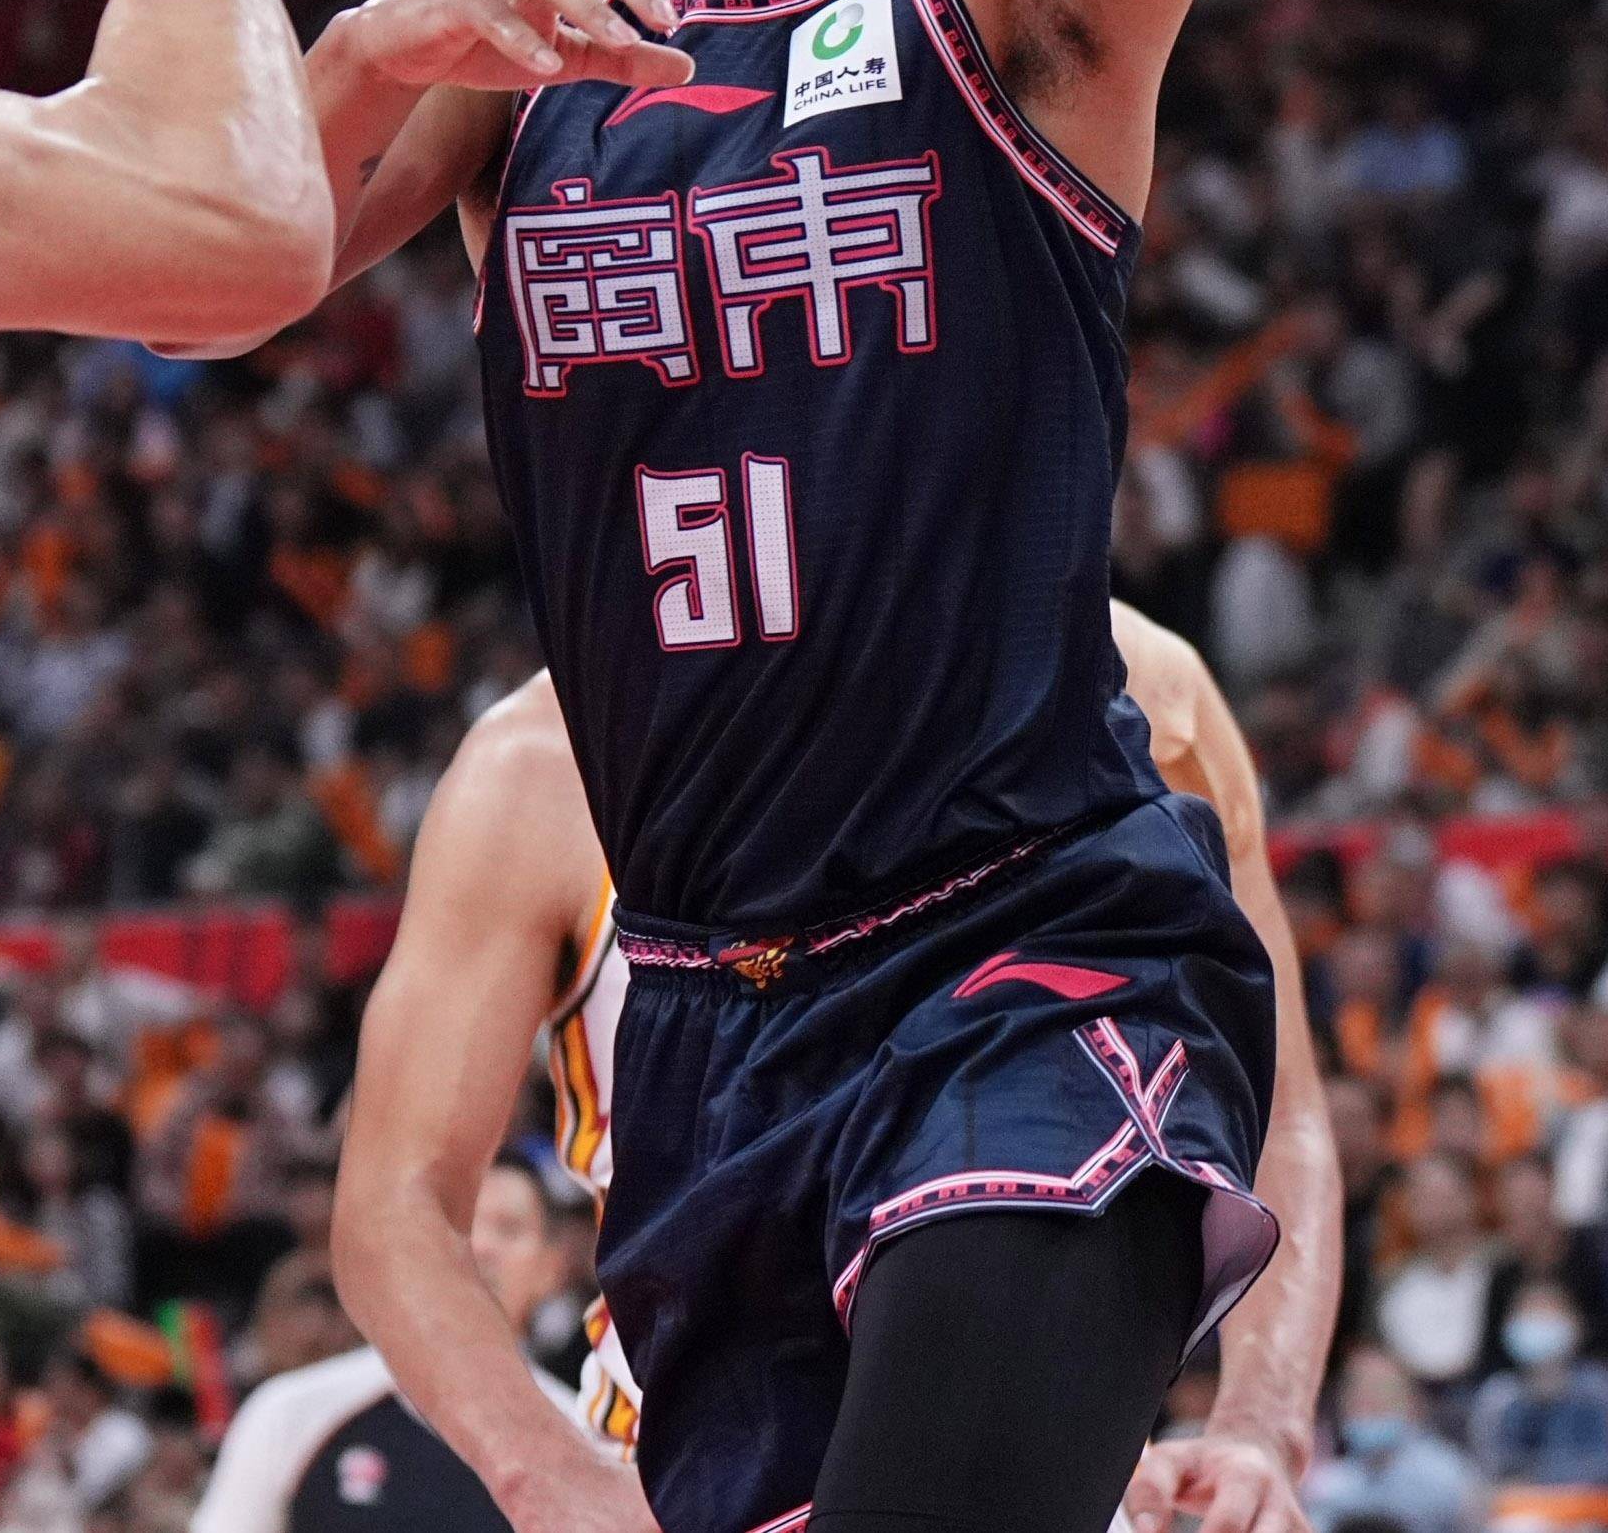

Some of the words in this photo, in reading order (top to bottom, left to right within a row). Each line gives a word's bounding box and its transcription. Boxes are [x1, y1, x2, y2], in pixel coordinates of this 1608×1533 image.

[793, 87, 844, 111] CHINA
[849, 77, 887, 94] LIFE
[794, 56, 887, 98] 中国人寿
[634, 451, 800, 652] 51
